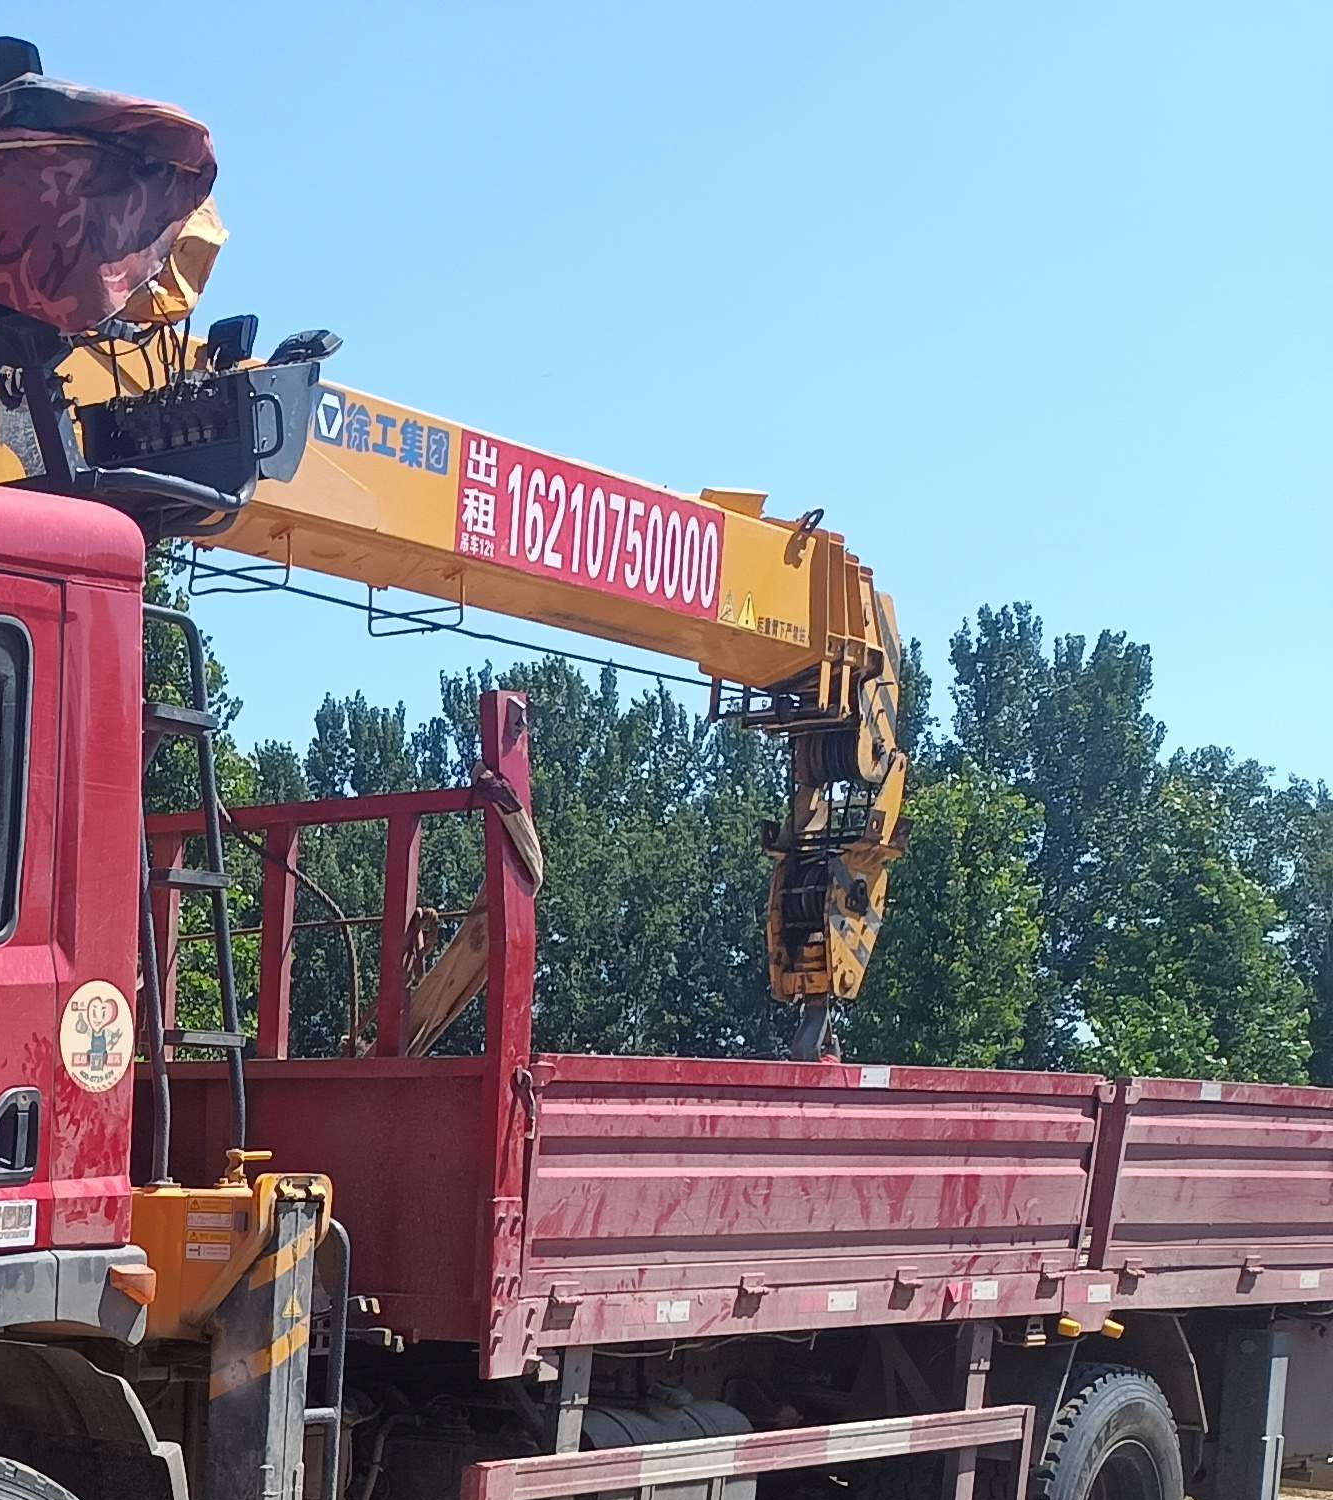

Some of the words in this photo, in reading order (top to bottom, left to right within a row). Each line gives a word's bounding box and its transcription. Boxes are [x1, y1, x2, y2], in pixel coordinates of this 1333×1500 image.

[346, 403, 450, 475] 徐工集团
[461, 438, 499, 538] 出租
[460, 533, 497, 559] 吊车12t
[506, 463, 719, 609] 16210750000
